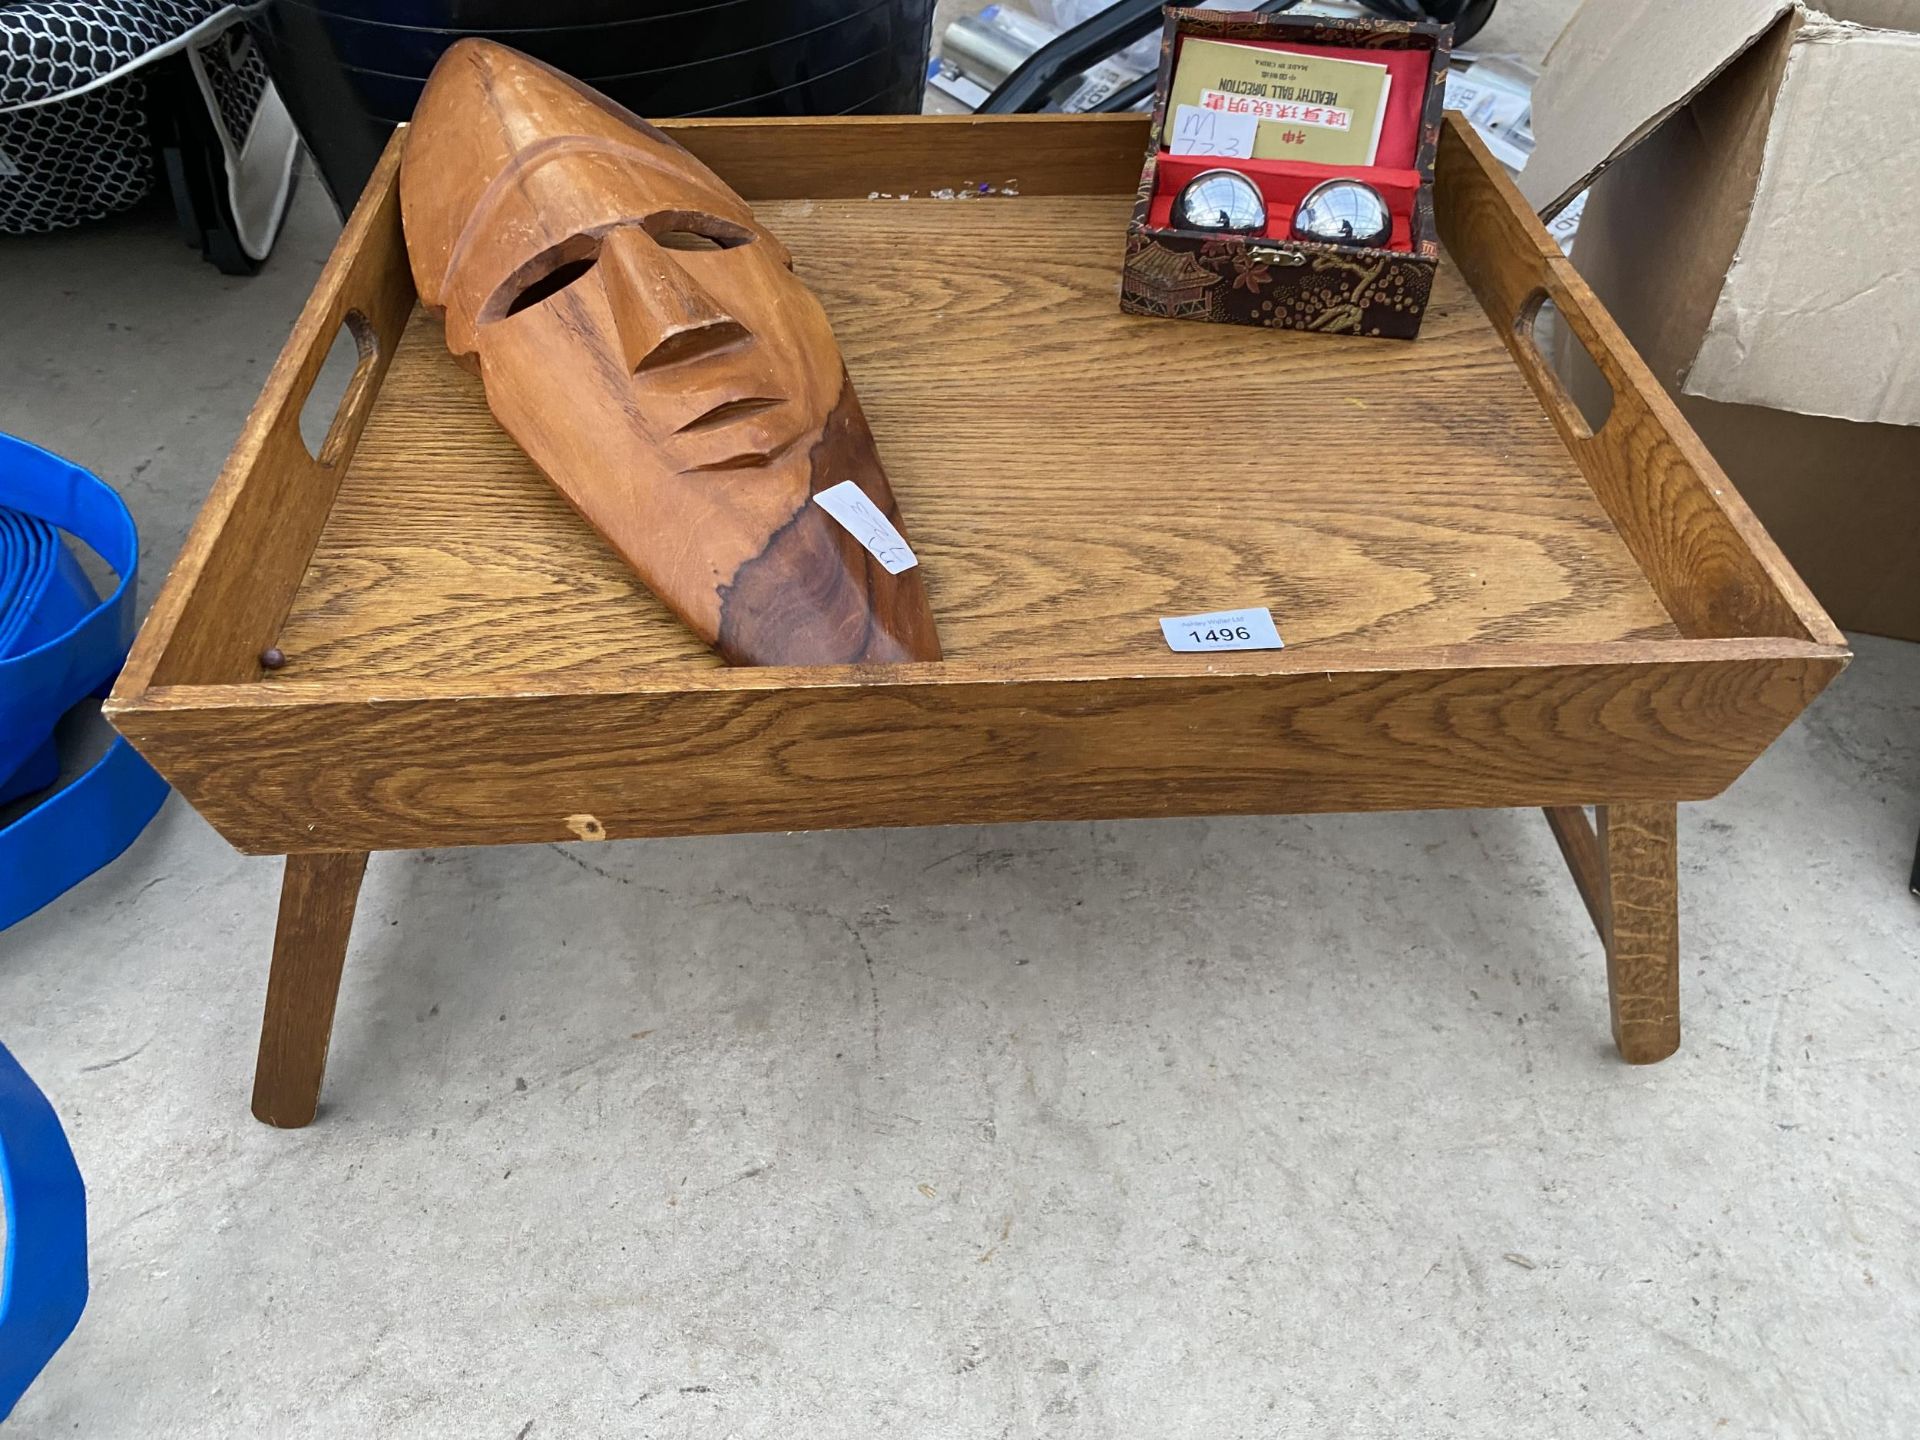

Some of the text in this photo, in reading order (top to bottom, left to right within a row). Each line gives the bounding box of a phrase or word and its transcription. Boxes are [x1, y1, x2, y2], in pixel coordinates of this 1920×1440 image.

[1255, 59, 1277, 68] CHINA
[1286, 63, 1309, 72] MADE
[1218, 77, 1338, 106] HEALTHY BALL DIRECTION
[1188, 626, 1251, 643] 1496
